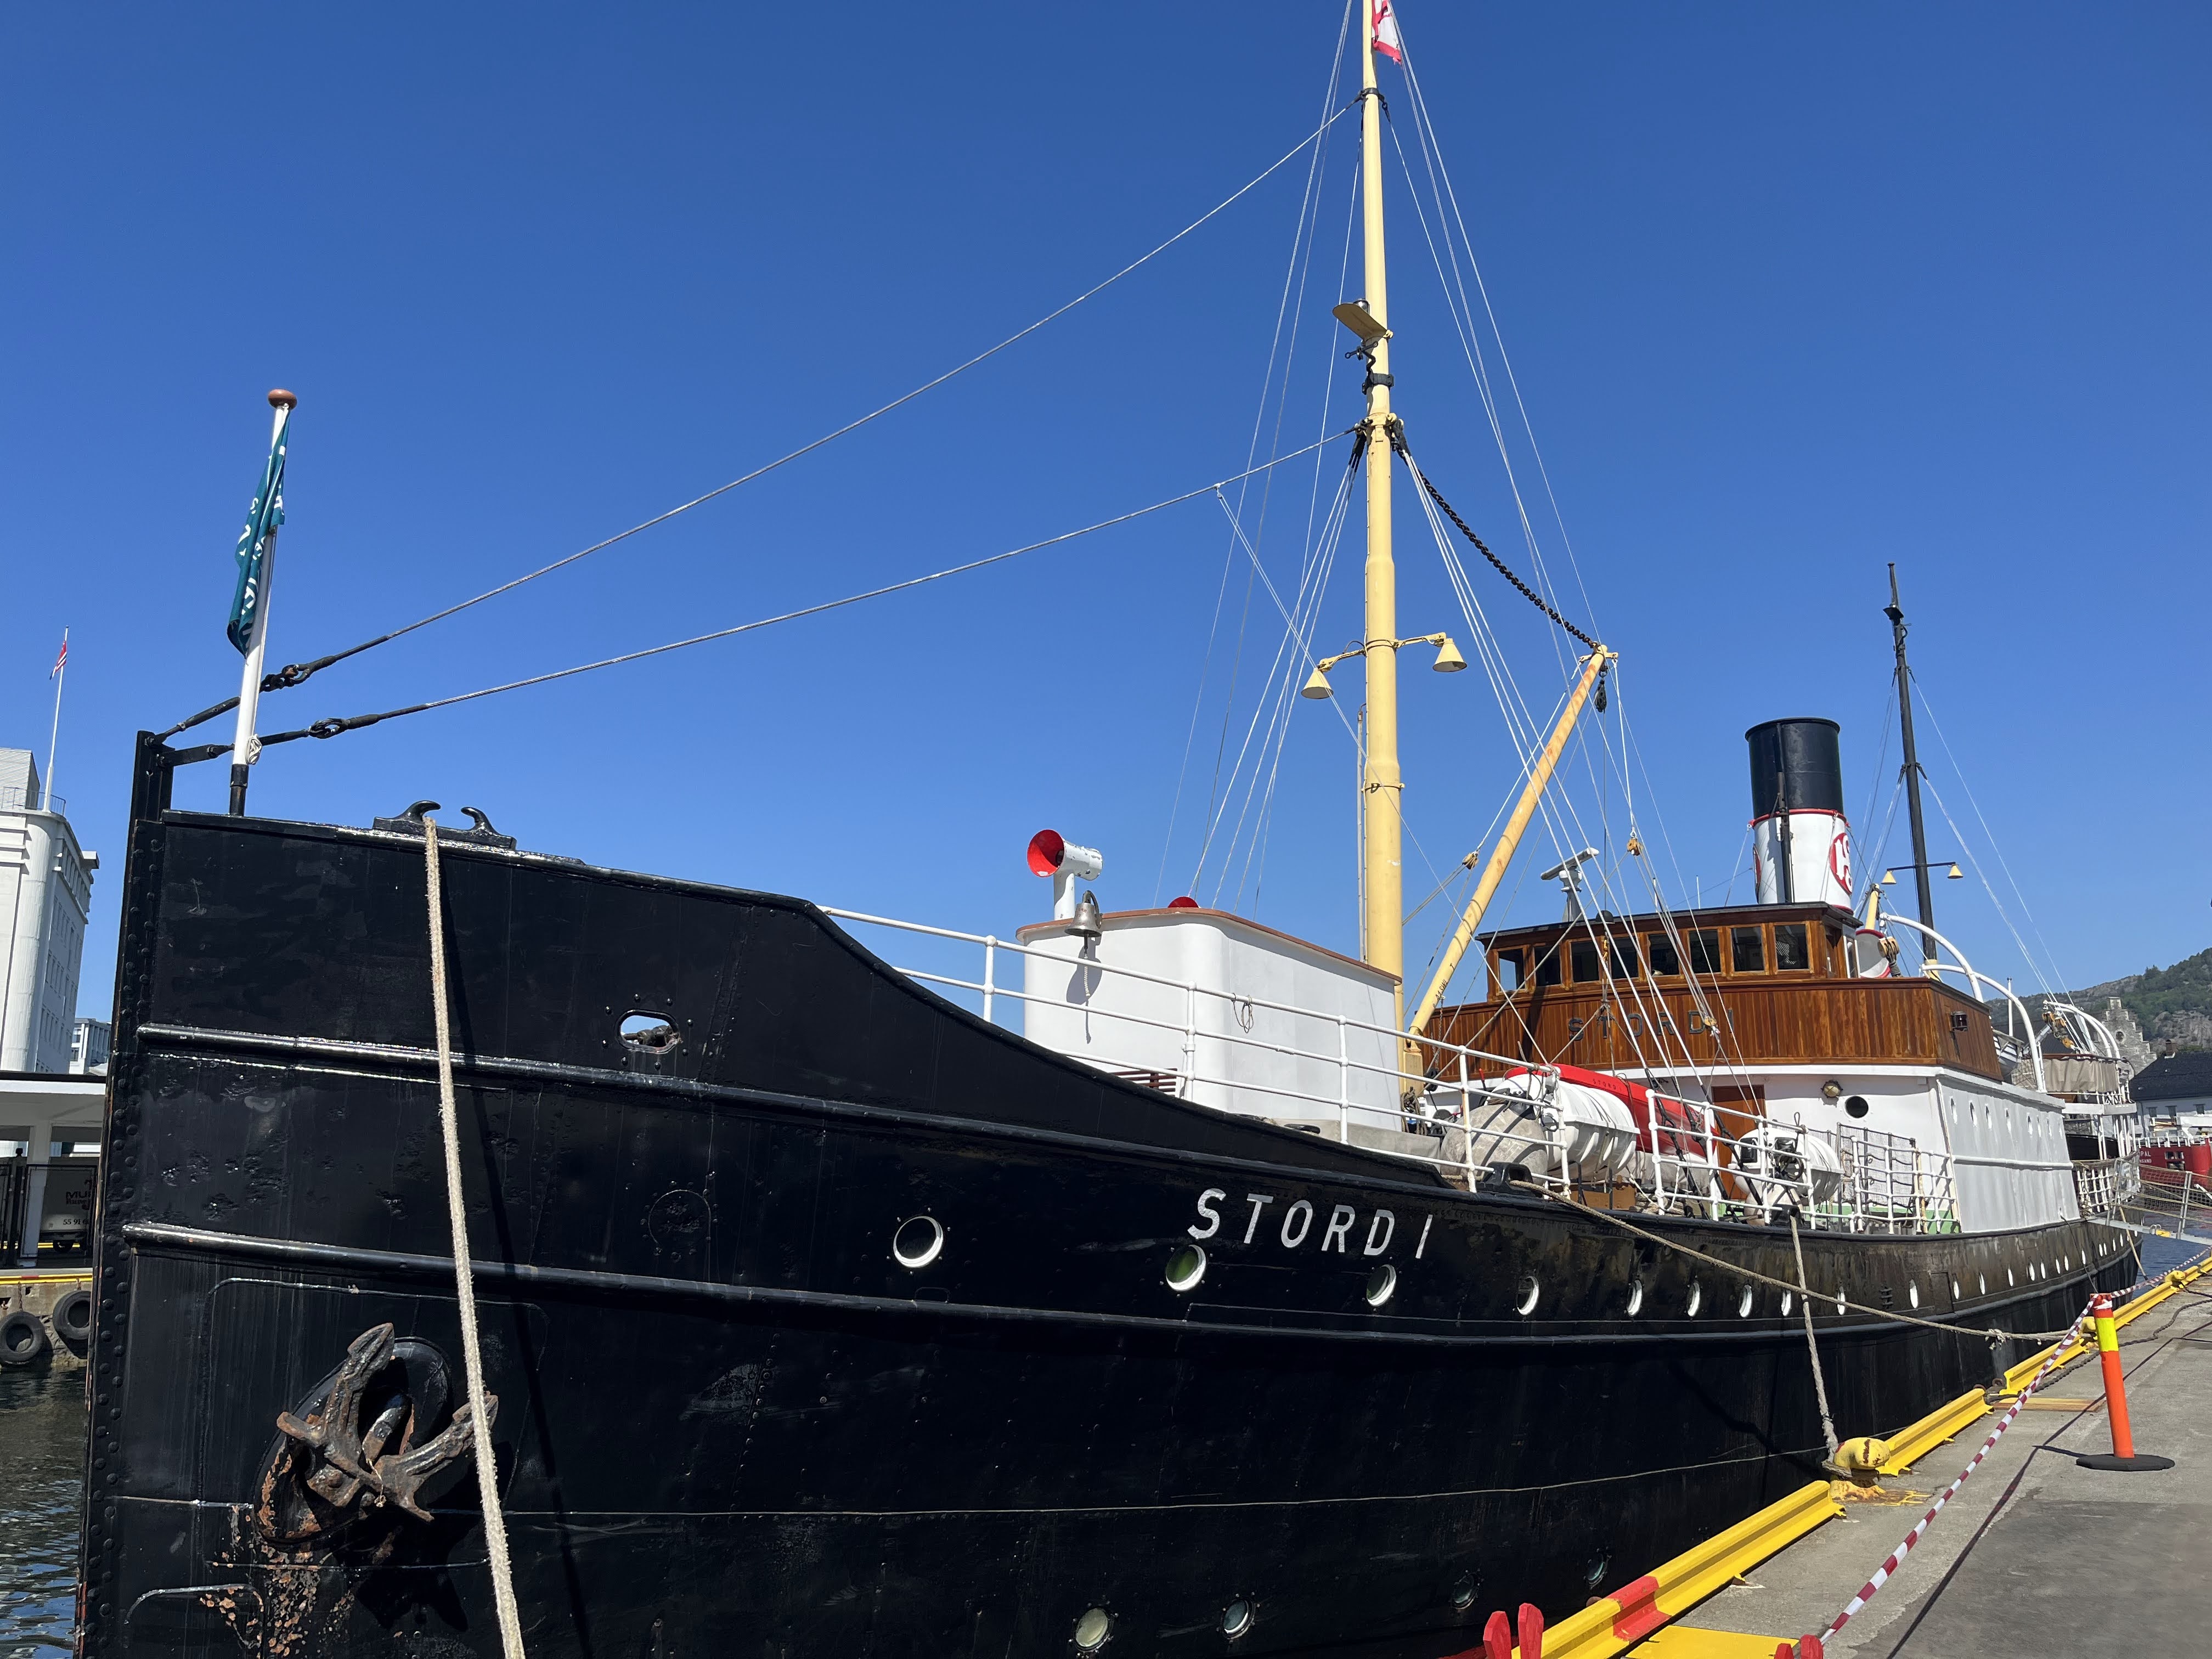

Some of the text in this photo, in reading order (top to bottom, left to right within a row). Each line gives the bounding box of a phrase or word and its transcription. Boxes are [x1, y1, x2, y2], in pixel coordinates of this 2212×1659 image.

[1568, 1009, 1705, 1041] STORD
[1593, 1078, 1616, 1090] STORD
[1187, 1188, 1395, 1256] STORD
